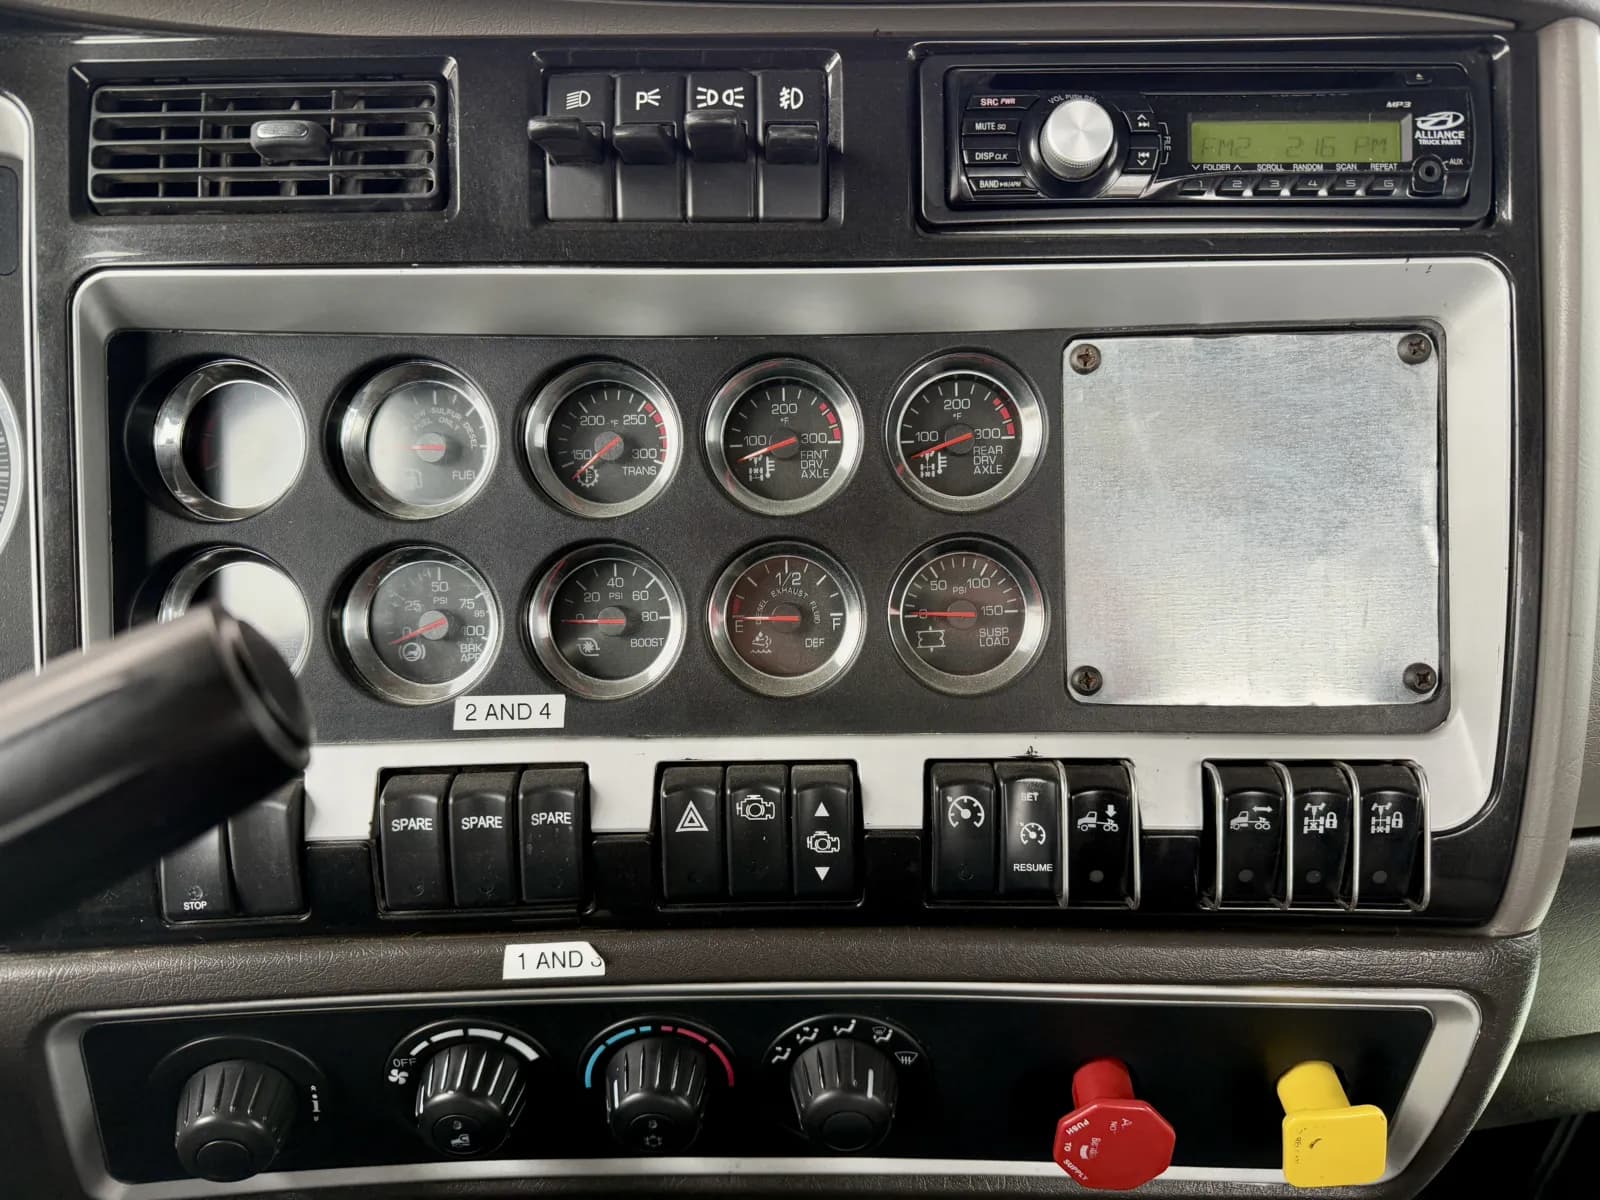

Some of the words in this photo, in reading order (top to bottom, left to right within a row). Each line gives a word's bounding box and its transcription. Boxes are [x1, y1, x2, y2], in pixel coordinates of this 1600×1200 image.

[980, 98, 999, 106] SRC
[975, 122, 996, 131] MUTE
[1414, 131, 1465, 139] ALLIANCE
[1201, 137, 1251, 159] FM2
[1353, 136, 1388, 157] PM
[975, 152, 994, 160] DISP
[1202, 163, 1231, 171] FOLDER
[1256, 163, 1284, 172] SCROLL
[1292, 163, 1324, 172] RANDOM
[1335, 163, 1358, 172] SCAN
[1370, 162, 1398, 172] REPEAT
[1449, 158, 1464, 166] AUX
[979, 180, 999, 188] BAND
[1232, 180, 1242, 188] 2
[1269, 180, 1280, 188] 3
[1345, 180, 1356, 188] 5
[1383, 180, 1394, 188] 6
[771, 403, 798, 415] 200
[943, 398, 971, 410] 200
[580, 415, 605, 426] 200
[622, 414, 647, 425] 250
[801, 432, 828, 444] 300
[915, 430, 939, 442] 100
[973, 427, 1001, 440] 300
[743, 434, 767, 446] 100
[572, 449, 592, 460] 150
[631, 448, 657, 459] 300
[800, 449, 829, 460] FRNT
[972, 445, 1004, 455] REAR
[800, 460, 824, 470] DRV
[973, 455, 997, 465] DRV
[452, 470, 477, 480] FUEL
[621, 466, 657, 476] TRANS
[800, 468, 830, 479] AXLE
[973, 464, 1004, 475] AXLE
[606, 577, 625, 588] 40
[775, 572, 802, 588] 1/2
[930, 579, 948, 591] 50
[966, 577, 991, 589] 100
[431, 581, 449, 592] 50
[952, 586, 967, 595] PSI
[583, 591, 601, 602] 20
[608, 592, 624, 600] PSI
[631, 590, 649, 601] 60
[770, 587, 809, 599] EXHAUST
[404, 600, 421, 612] 25
[433, 596, 448, 605] PSI
[458, 598, 475, 609] 75
[980, 604, 1004, 616] 150
[641, 611, 659, 622] 80
[831, 617, 841, 631] F
[463, 625, 486, 637] 100
[979, 626, 1009, 638] SUSP
[630, 637, 665, 648] BOOST
[804, 637, 825, 648] DEF
[979, 637, 1010, 647] LOAD
[459, 643, 482, 653] BRK
[465, 703, 477, 721] 2
[485, 703, 532, 721] AND
[539, 702, 551, 720] 4
[1021, 792, 1039, 802] SET
[391, 817, 433, 832] SPARE
[461, 815, 503, 830] SPARE
[531, 812, 572, 826] SPARE
[1013, 863, 1053, 872] RESUME
[183, 901, 208, 911] STOP
[518, 952, 525, 970] 1
[536, 950, 583, 969] AND
[392, 1057, 417, 1068] OFF
[1066, 1119, 1090, 1135] PUSH
[1064, 1142, 1072, 1152] TO
[1063, 1158, 1089, 1181] SUPPLY
